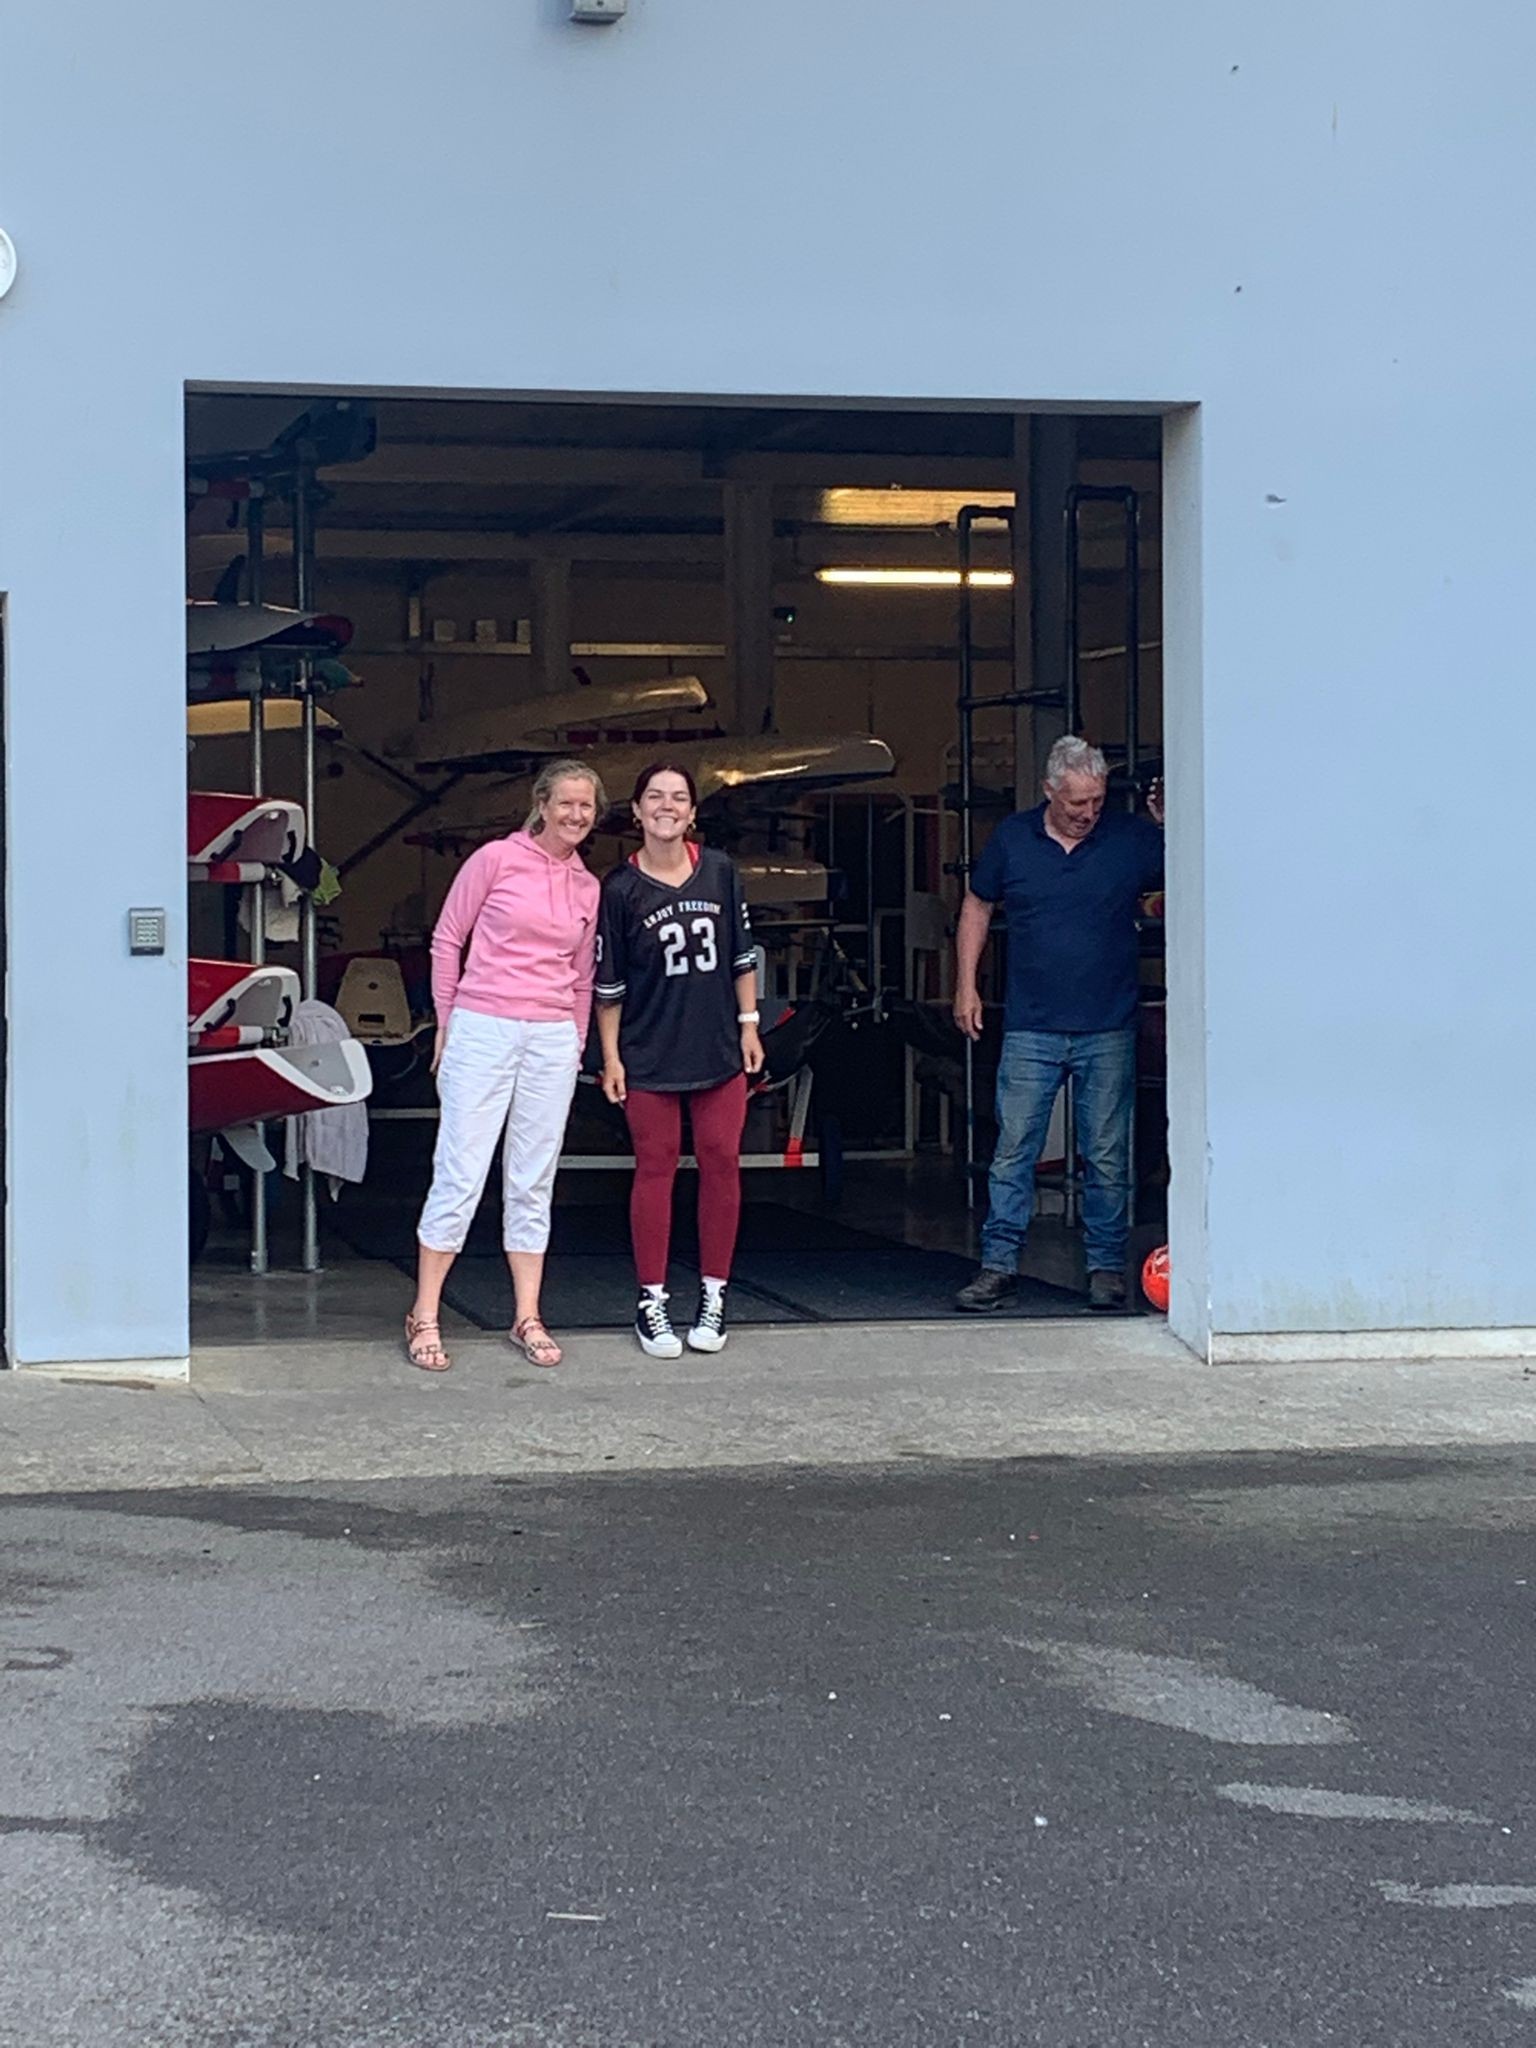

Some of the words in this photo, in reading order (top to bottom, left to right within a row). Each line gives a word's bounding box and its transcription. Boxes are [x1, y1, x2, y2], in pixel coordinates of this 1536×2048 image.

[643, 904, 673, 929] ENJOY
[678, 900, 721, 914] FREEDOM
[659, 917, 717, 977] 23
